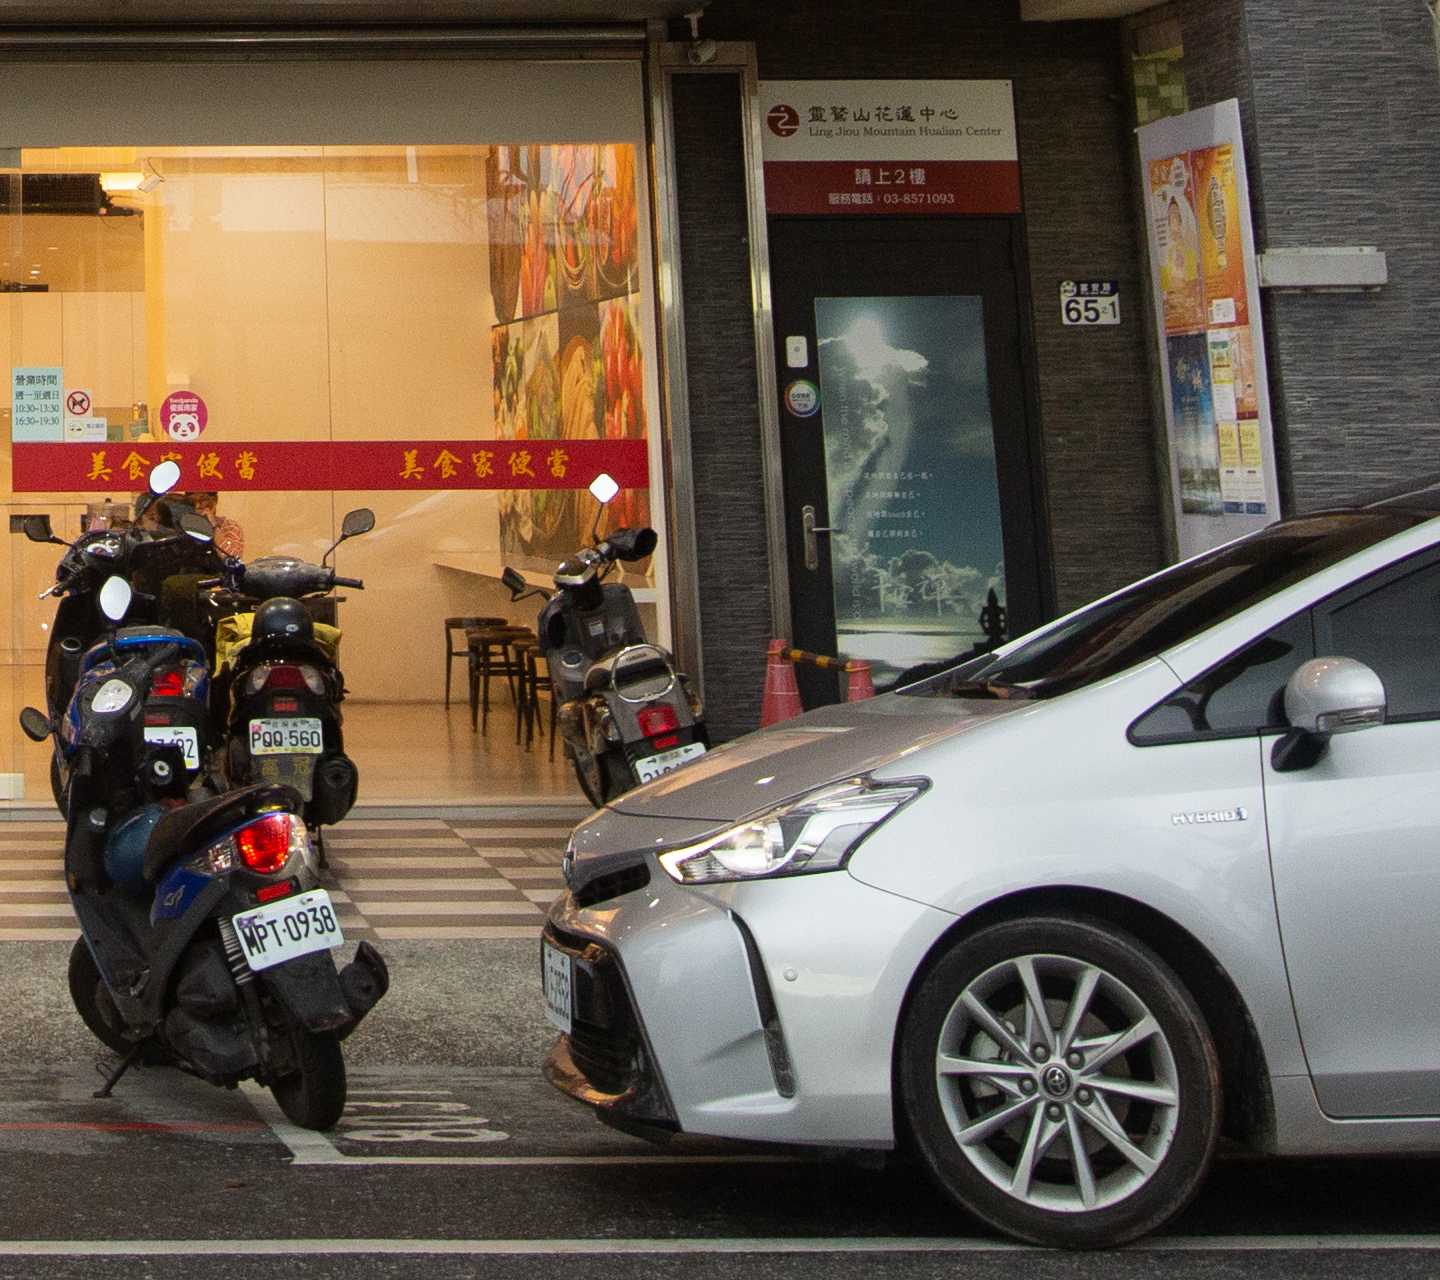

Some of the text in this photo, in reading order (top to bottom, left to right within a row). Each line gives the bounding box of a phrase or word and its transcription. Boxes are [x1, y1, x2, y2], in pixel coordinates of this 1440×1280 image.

[808, 105, 959, 123] 靈鷲山花蓮中心
[809, 126, 1001, 138] Ling Jiou Mountain Hualian Center
[855, 168, 926, 185] 請上2樓
[15, 374, 58, 386] 營業時間
[87, 451, 258, 482] 美食便當
[400, 449, 570, 481] 美食家便當
[1172, 809, 1236, 825] HYBRID
[241, 905, 337, 957] MPT-0938
